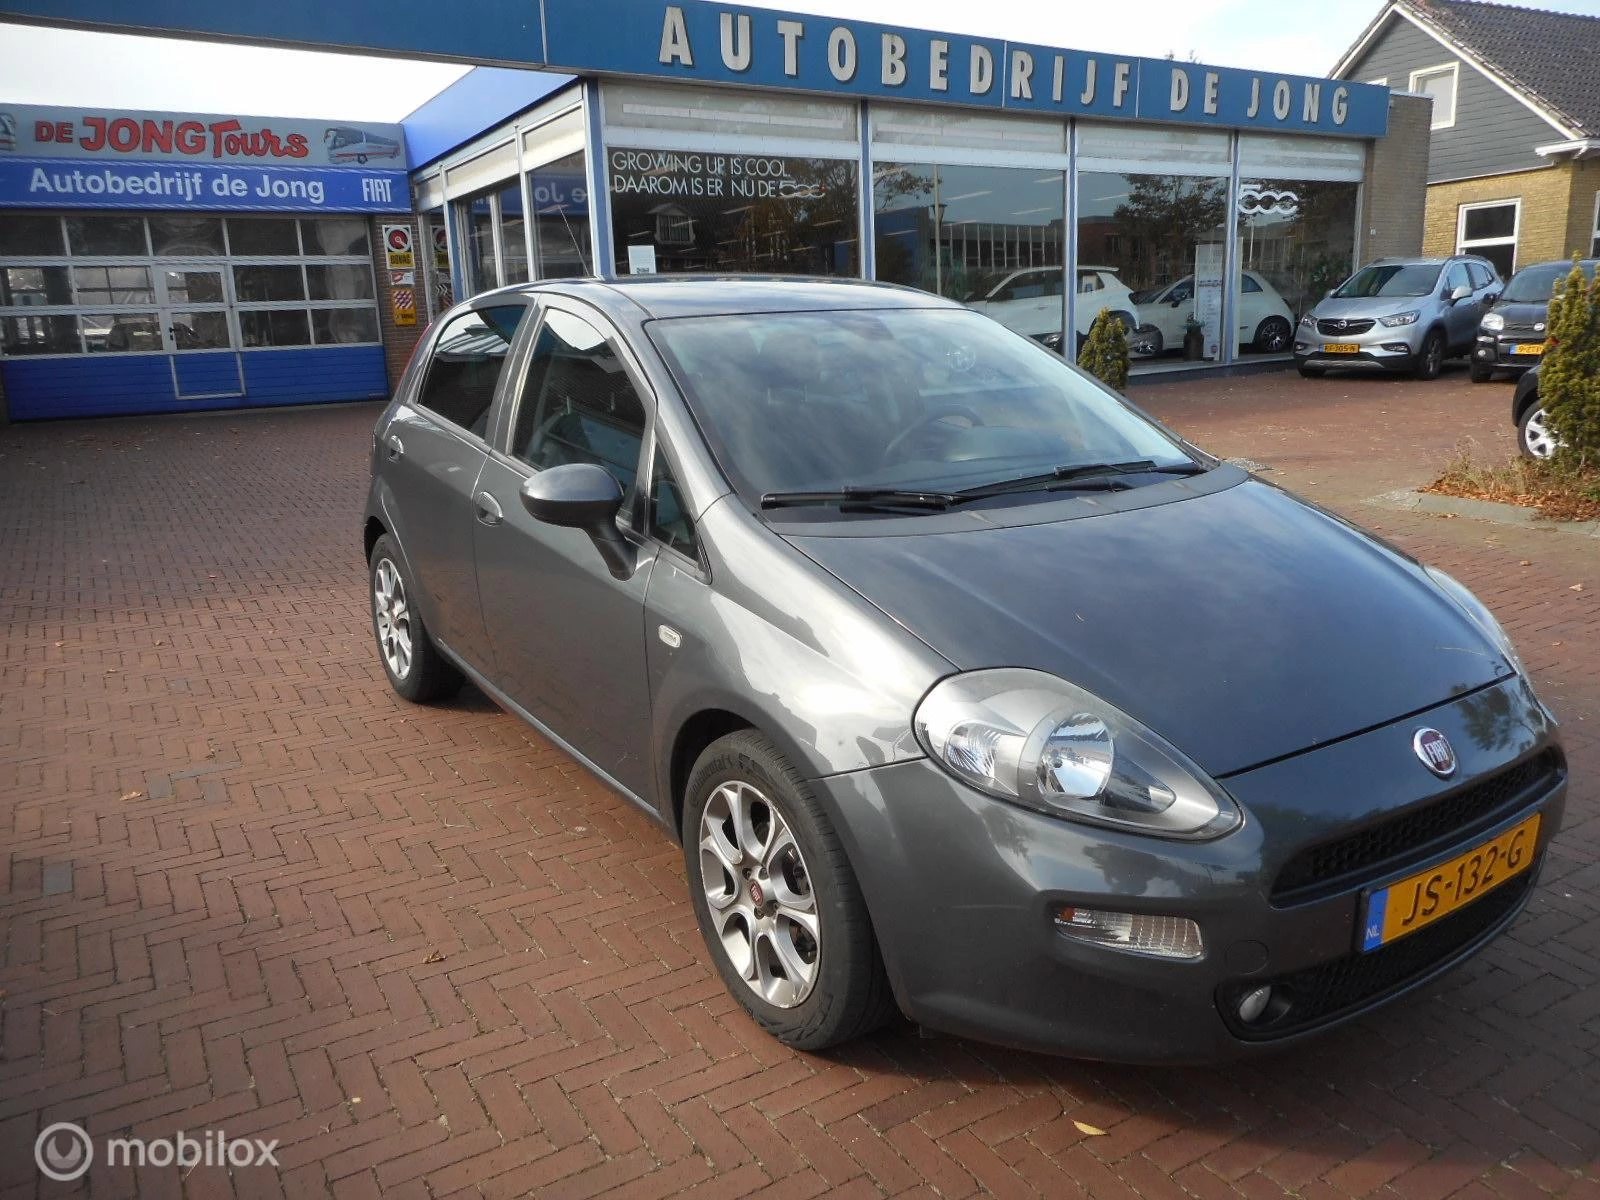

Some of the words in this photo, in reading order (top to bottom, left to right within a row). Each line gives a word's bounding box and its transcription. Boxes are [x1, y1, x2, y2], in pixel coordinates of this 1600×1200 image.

[658, 6, 1131, 106] AUTOBEDRIJF
[1170, 68, 1219, 114] DE
[1247, 77, 1350, 125] JONG
[35, 120, 73, 143] DE
[80, 117, 206, 153] JONG
[209, 119, 310, 159] Tours
[612, 151, 702, 173] GROWING
[706, 157, 725, 174] UP
[730, 157, 742, 174] IS
[30, 168, 202, 201] Autobedrijf
[211, 173, 248, 198] de
[256, 175, 325, 204] Jong
[362, 178, 392, 203] FIAT
[614, 174, 688, 194] DAAROM
[692, 177, 704, 195] IS
[708, 178, 723, 196] ER
[759, 180, 776, 197] DE
[1401, 830, 1525, 926] JS-132-G
[1365, 924, 1380, 940] NL
